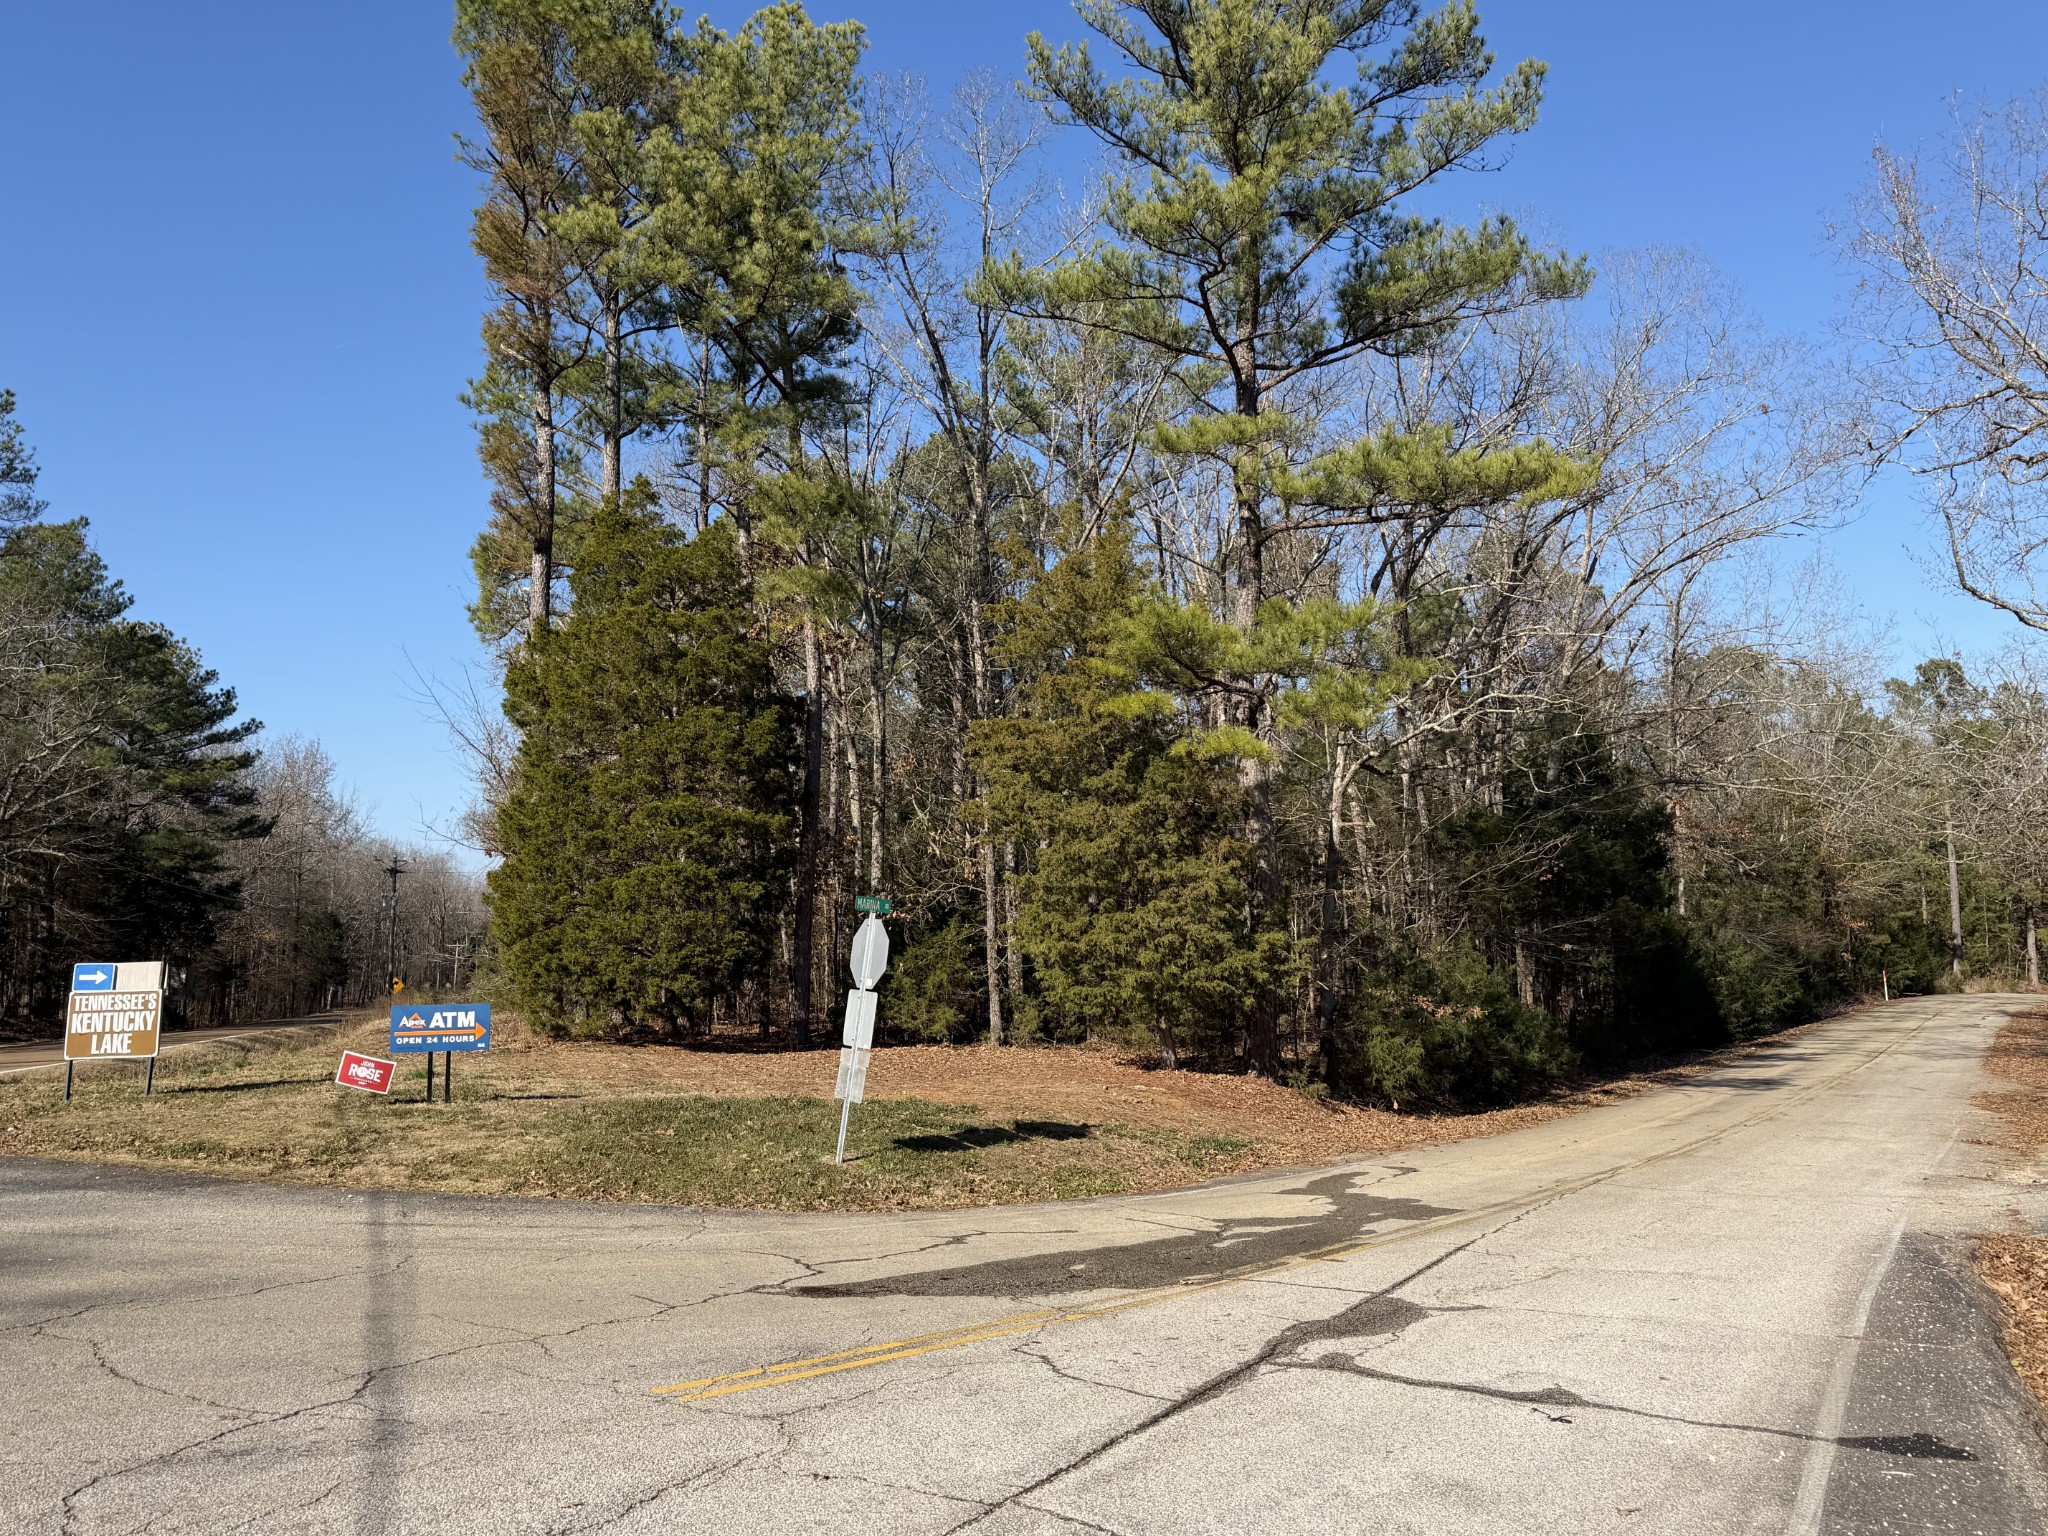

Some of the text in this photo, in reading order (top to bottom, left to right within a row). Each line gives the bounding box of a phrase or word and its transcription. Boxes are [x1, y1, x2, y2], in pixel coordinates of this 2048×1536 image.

[857, 898, 881, 910] MARINA
[74, 993, 157, 1011] TENNESSEE'S
[71, 1011, 156, 1033] KENTUCKY
[398, 1011, 475, 1028] Apex ATM
[91, 1033, 132, 1054] LAKE
[442, 1035, 475, 1043] HOURS
[348, 1063, 384, 1083] ROSE
